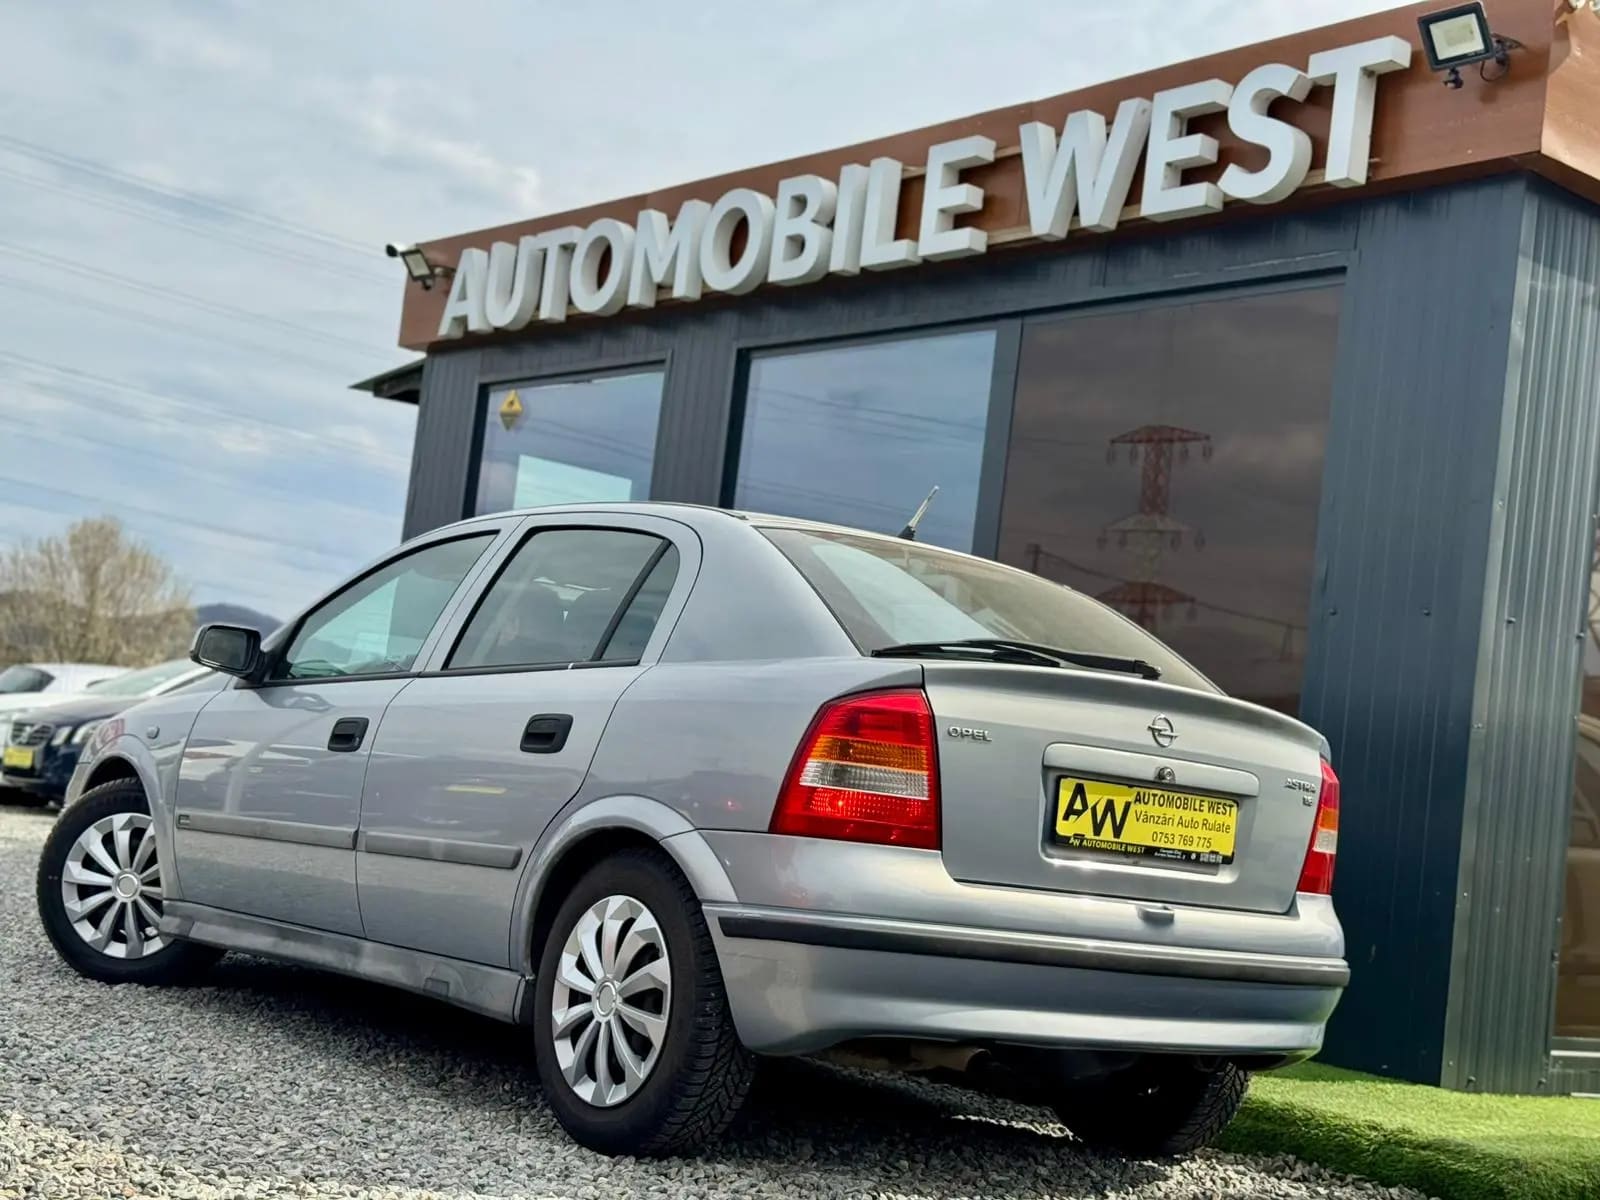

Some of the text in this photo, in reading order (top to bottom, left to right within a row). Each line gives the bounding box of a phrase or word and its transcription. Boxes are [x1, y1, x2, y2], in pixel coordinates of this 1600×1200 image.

[437, 35, 1412, 339] AUTOMOBILE WEST
[947, 726, 993, 742] OPEL
[1134, 791, 1234, 817] AUTOMOBILE WEST
[1177, 816, 1199, 829] Auto
[1201, 818, 1231, 833] Rulate
[1082, 838, 1126, 852] AUTOMOBILE
[1127, 844, 1145, 854] WEST
[1151, 831, 1213, 849] 0753 769 775
